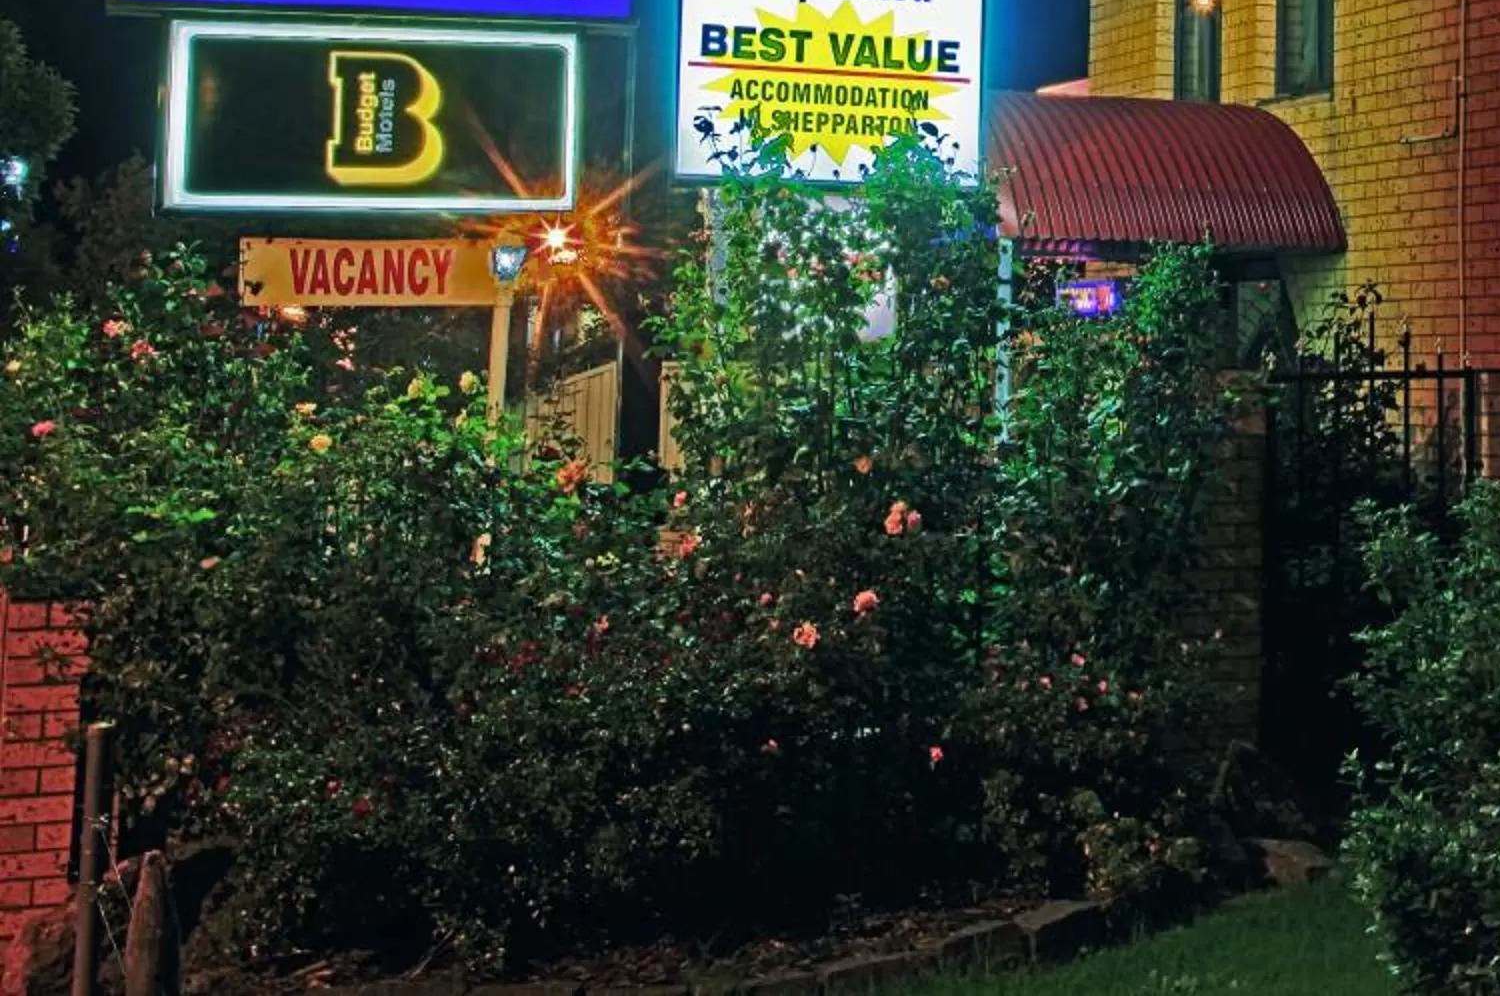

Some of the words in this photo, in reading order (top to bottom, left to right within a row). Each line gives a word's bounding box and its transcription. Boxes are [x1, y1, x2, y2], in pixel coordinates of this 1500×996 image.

[701, 23, 813, 64] BEST
[828, 31, 960, 73] VALUE
[355, 72, 377, 154] Budget
[376, 78, 396, 153] Motels
[729, 79, 929, 111] ACCOMMODATION
[289, 247, 455, 296] VACANCY
